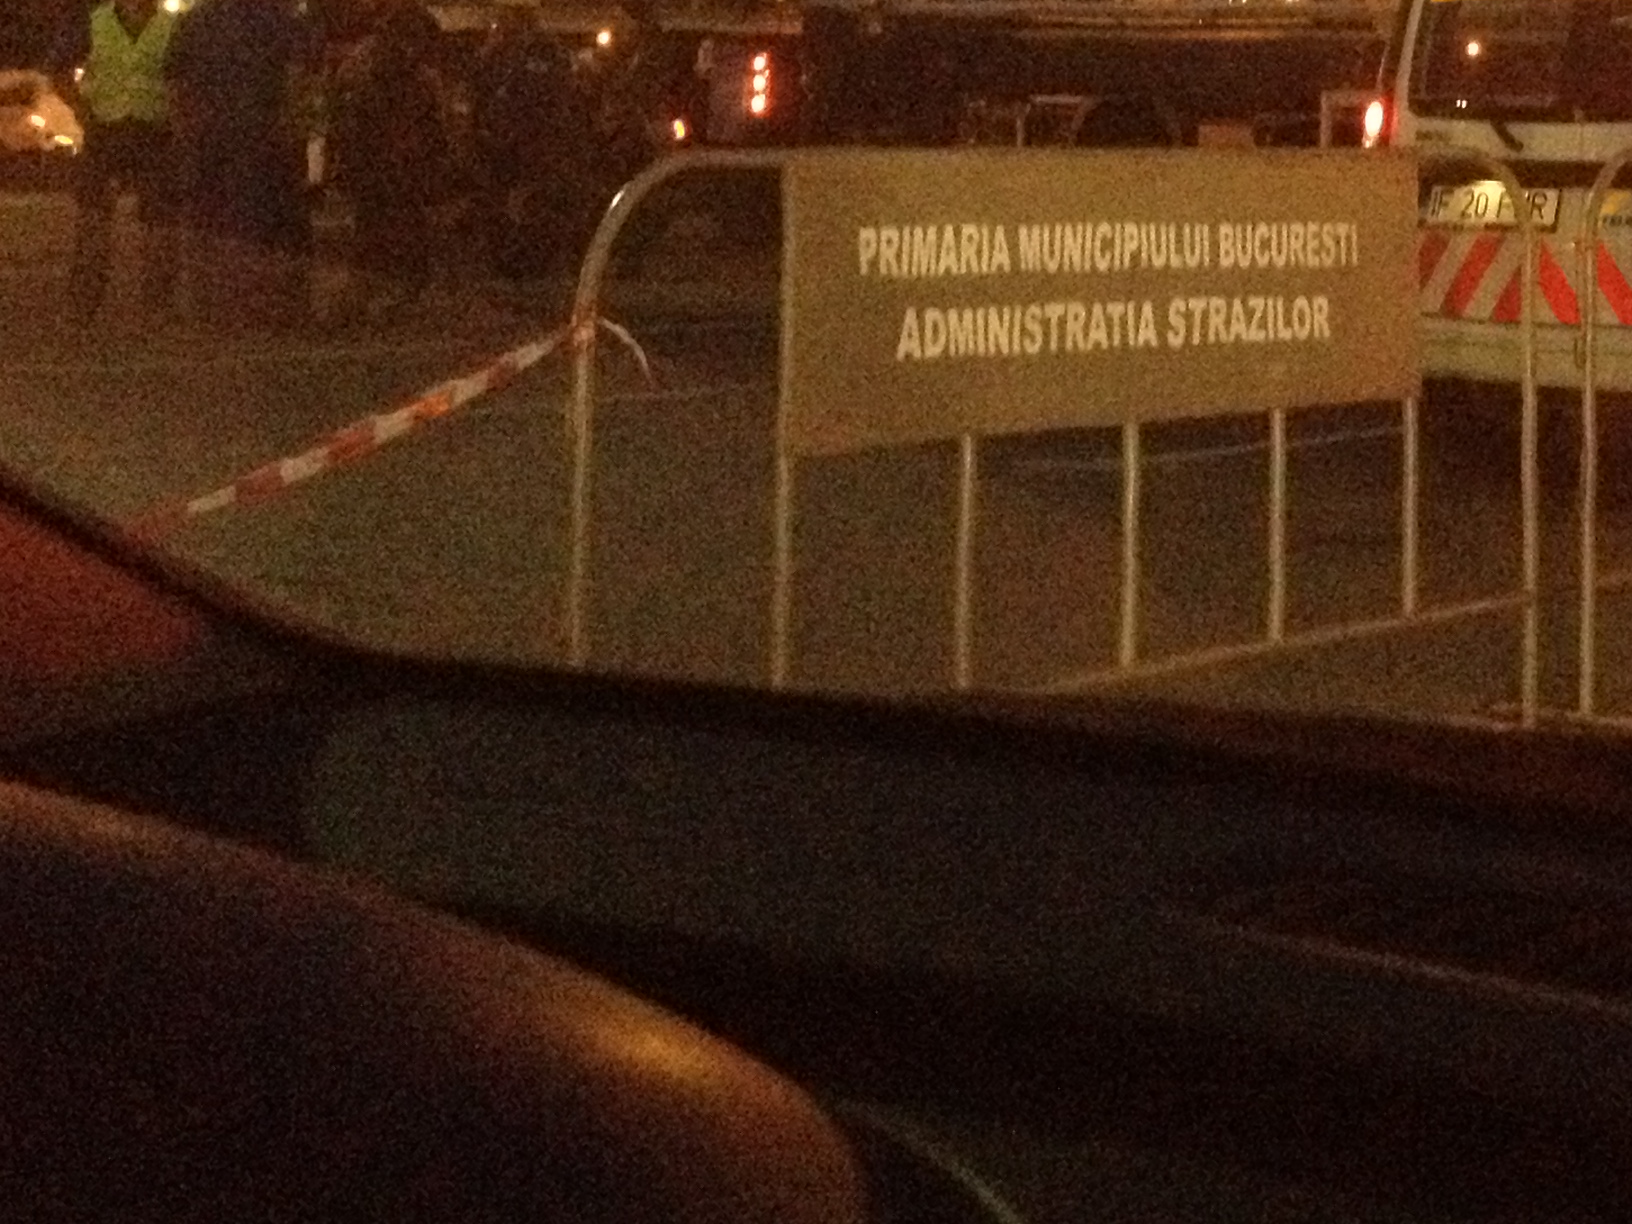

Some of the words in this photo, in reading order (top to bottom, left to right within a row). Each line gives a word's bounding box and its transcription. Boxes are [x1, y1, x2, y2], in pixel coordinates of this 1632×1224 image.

[858, 225, 1011, 275] PRIMARIA
[1018, 222, 1210, 273] MUNICIPIULUI
[1219, 221, 1359, 269] BUCURESTI
[897, 301, 1158, 361] ADMINISTRATIA
[1167, 295, 1330, 349] STRAZILOR
